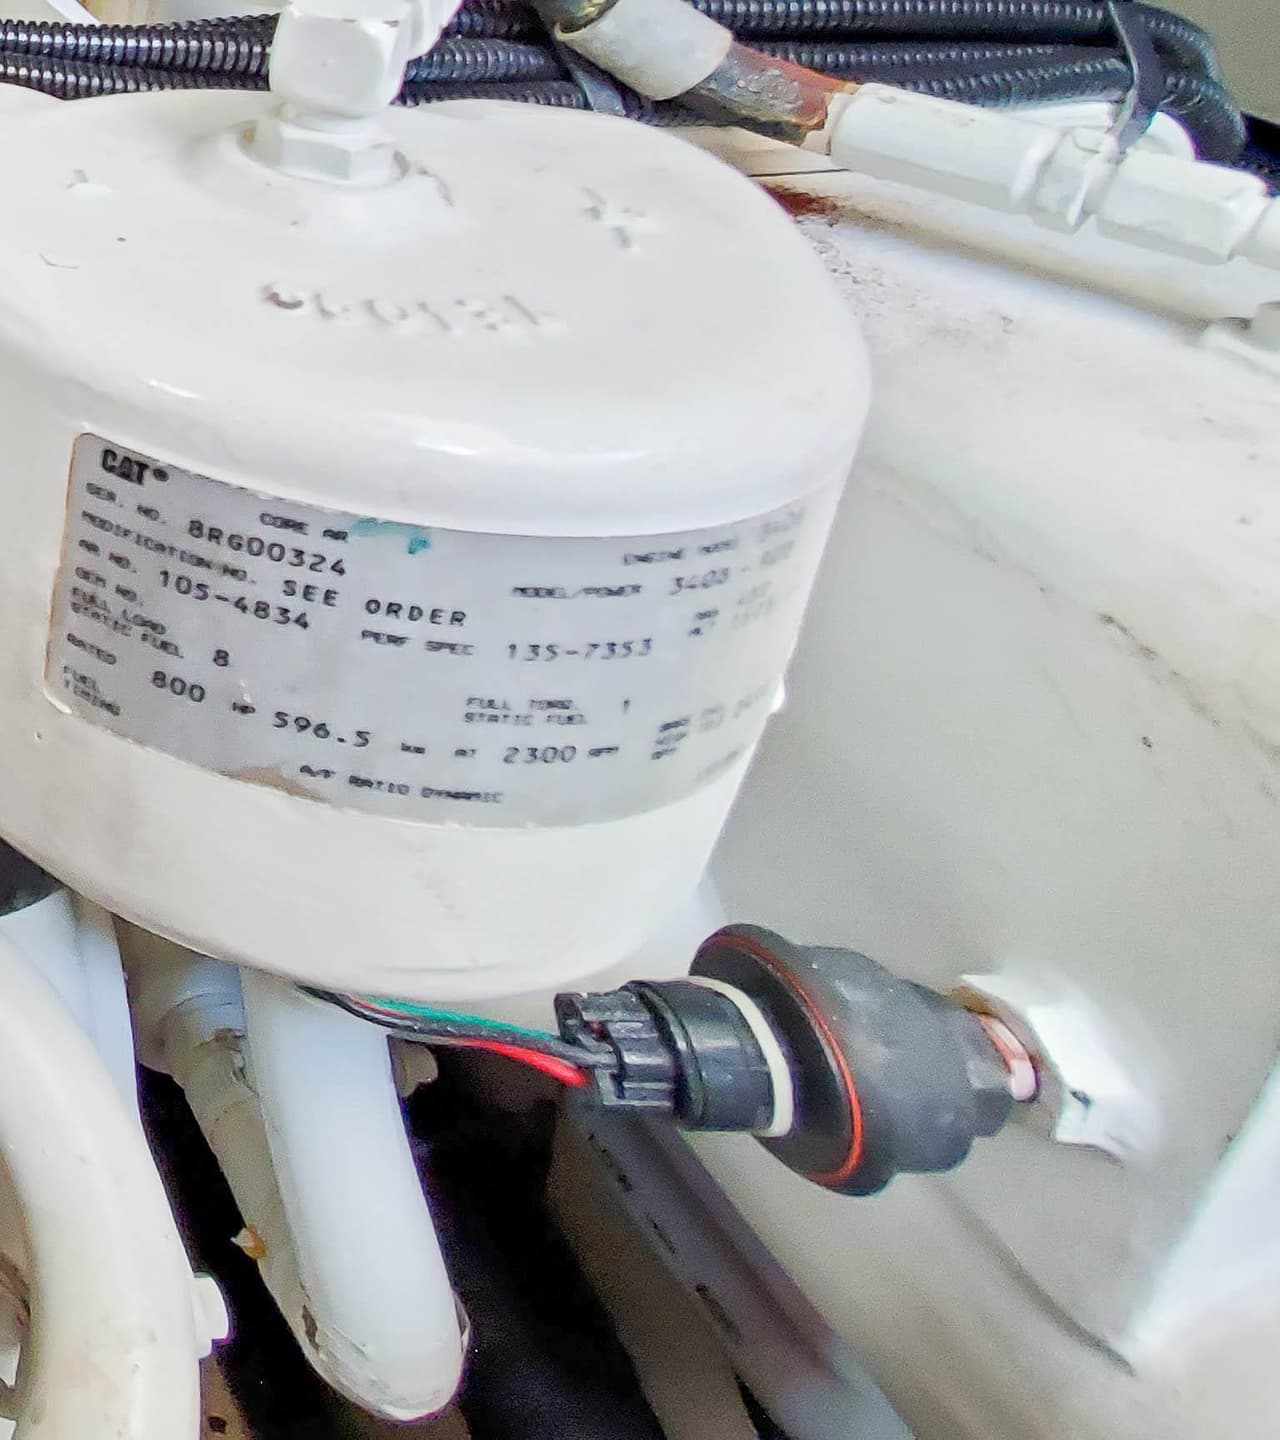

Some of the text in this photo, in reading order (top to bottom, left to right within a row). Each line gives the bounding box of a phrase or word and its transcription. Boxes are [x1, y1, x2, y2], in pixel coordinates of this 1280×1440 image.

[158, 569, 310, 630] 105-4834
[282, 579, 340, 607] SEE
[365, 598, 467, 627] ORDER
[212, 648, 231, 668] 8
[506, 637, 653, 662] 135-7353
[150, 669, 206, 704] 800
[272, 710, 371, 748] 596.5
[502, 744, 578, 764] 2300
